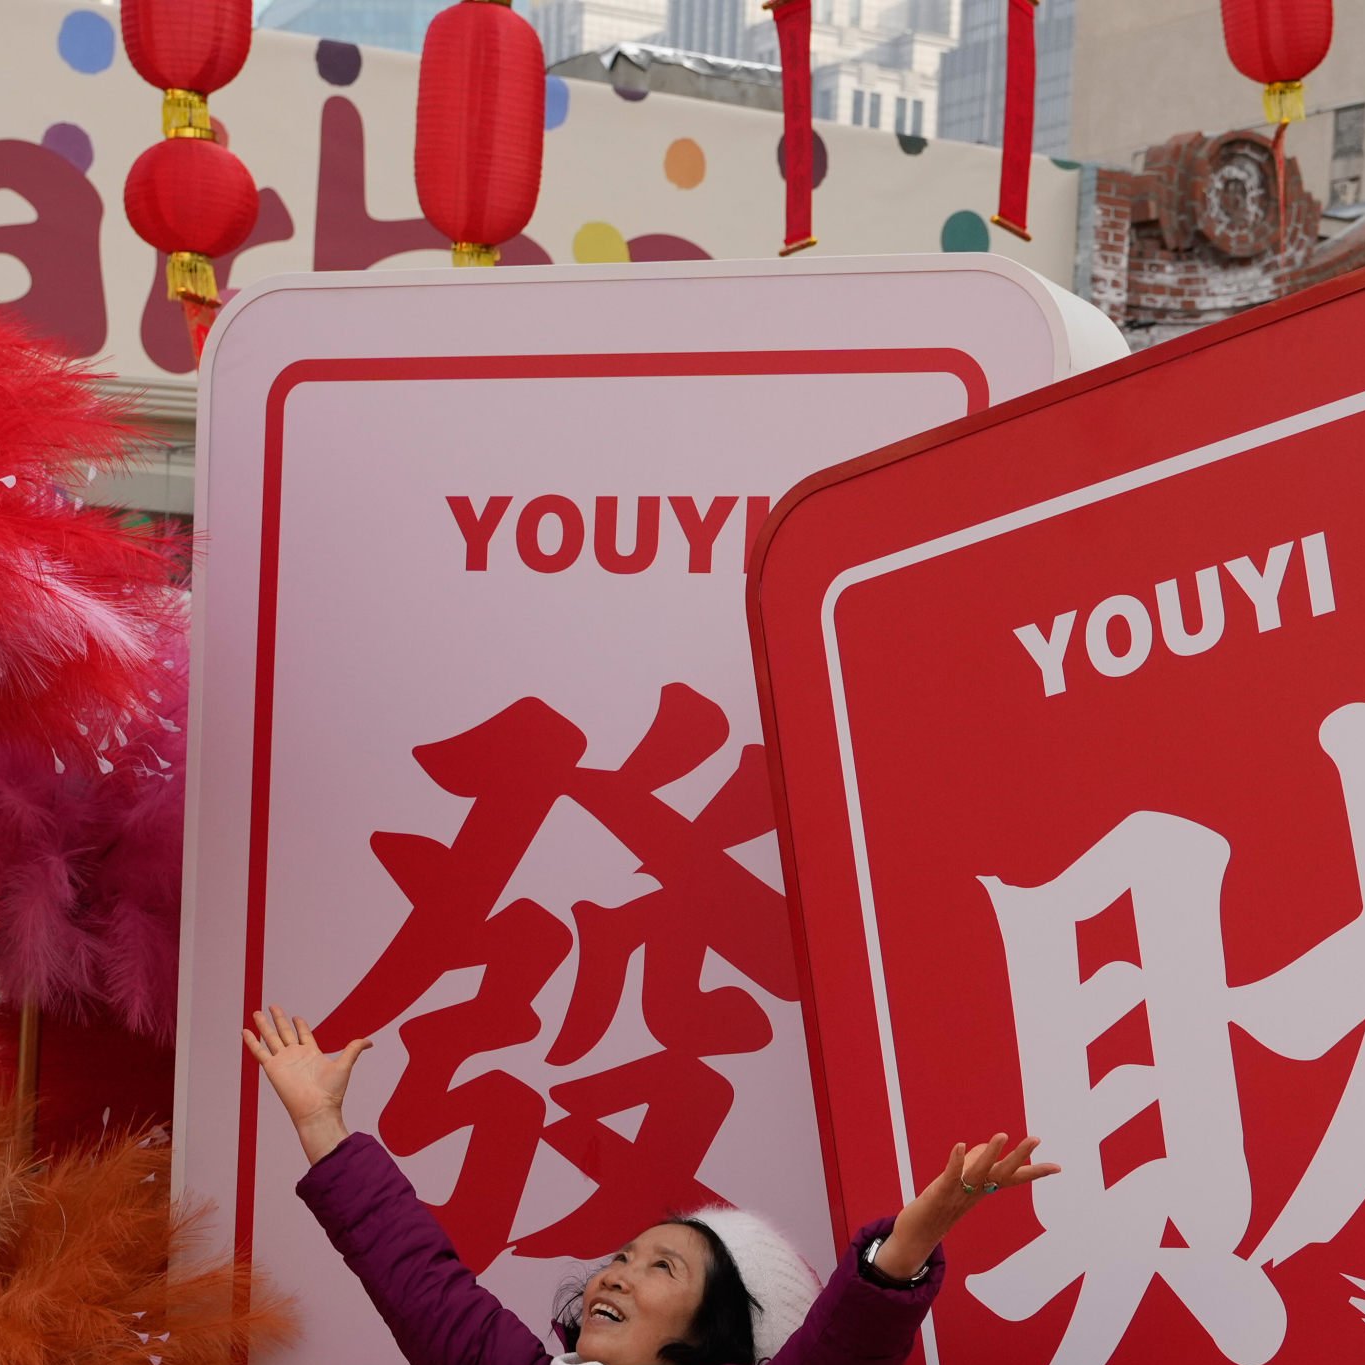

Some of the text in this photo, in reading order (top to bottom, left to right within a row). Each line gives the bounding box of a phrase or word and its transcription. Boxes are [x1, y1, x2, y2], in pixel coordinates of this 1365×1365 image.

[445, 494, 771, 575] YOUYI
[1013, 531, 1336, 698] YOUYI
[313, 682, 803, 1276] 發
